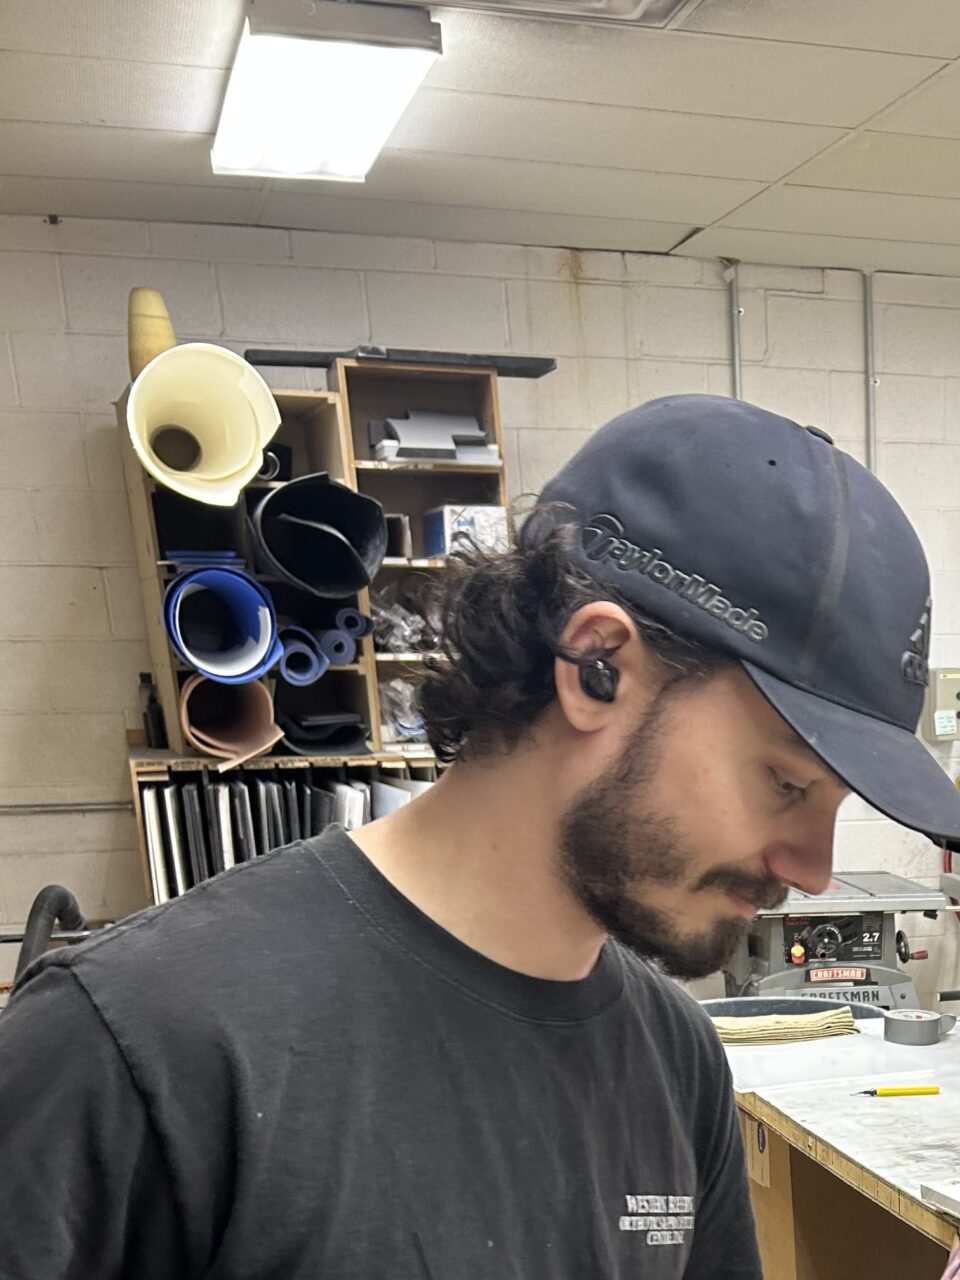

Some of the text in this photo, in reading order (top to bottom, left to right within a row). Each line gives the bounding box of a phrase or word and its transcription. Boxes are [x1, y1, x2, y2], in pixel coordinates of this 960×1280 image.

[581, 513, 769, 643] TaylorMade
[862, 932, 880, 942] 2.7
[812, 969, 862, 979] CRAFTSMAN
